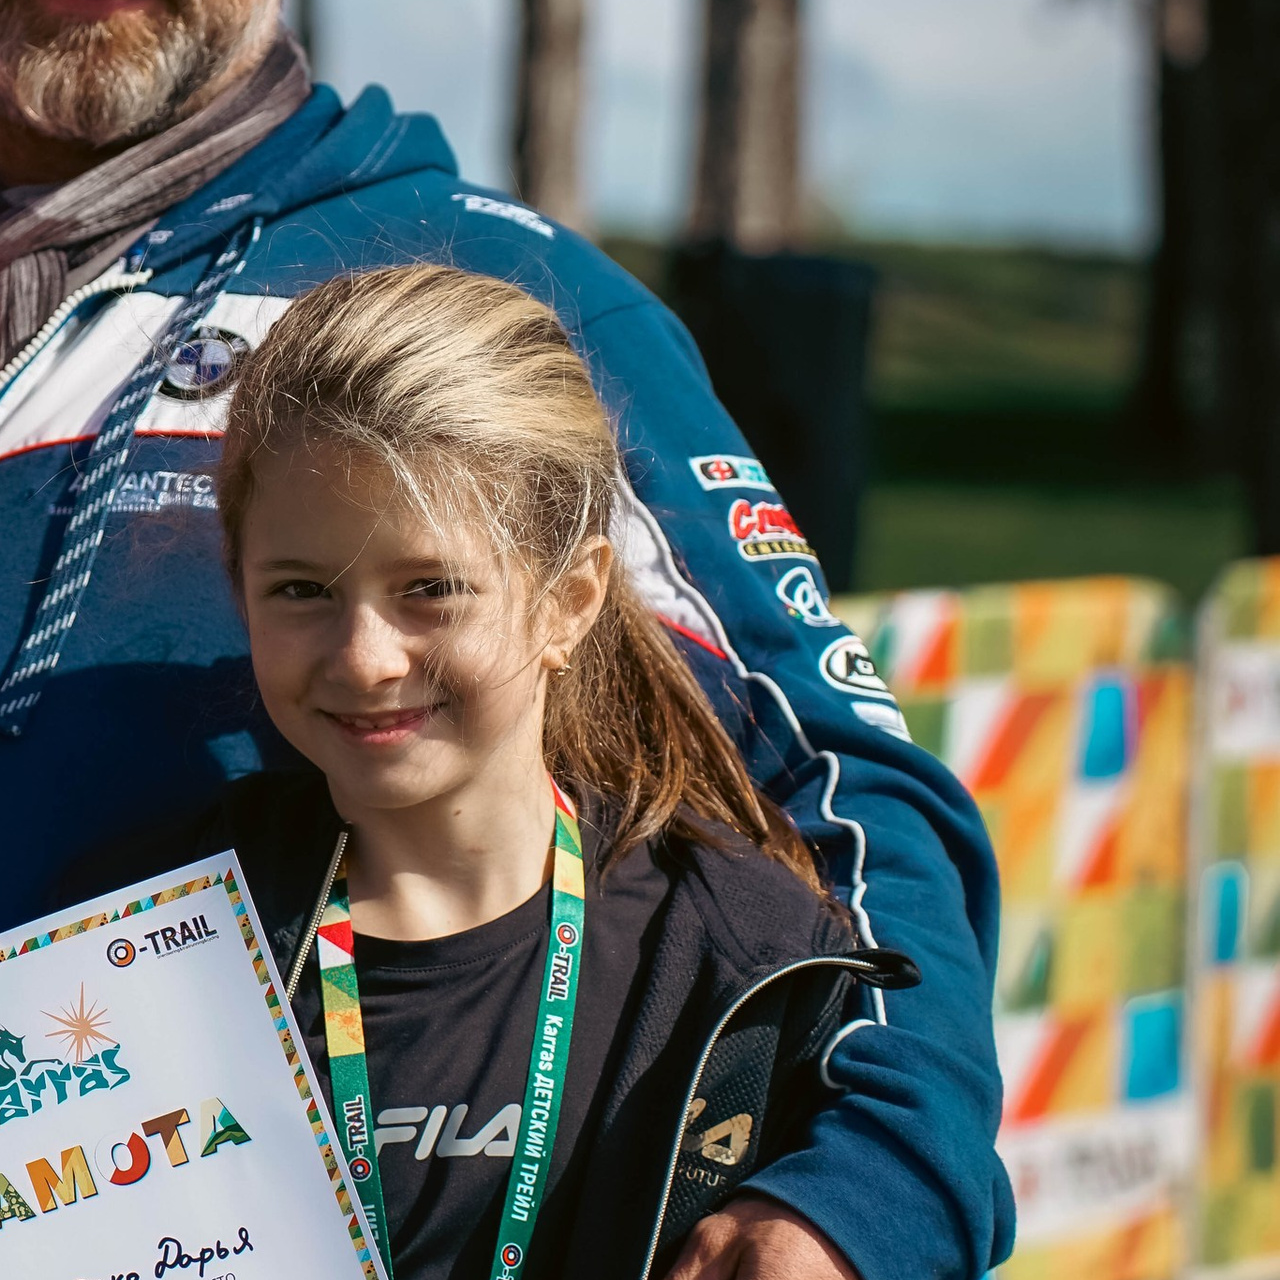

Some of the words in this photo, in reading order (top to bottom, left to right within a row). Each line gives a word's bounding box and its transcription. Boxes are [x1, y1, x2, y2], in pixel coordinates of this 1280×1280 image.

[106, 914, 218, 968] O-TRAIL
[547, 922, 578, 1002] O-TRAIL
[538, 1014, 564, 1071] Karras
[343, 1094, 372, 1182] O-TRAIL
[373, 1103, 522, 1161] FILA
[524, 1072, 555, 1158] ДЕТСКИЙ
[511, 1162, 540, 1222] ТРЕЙЛ
[154, 1227, 254, 1278] Дарья
